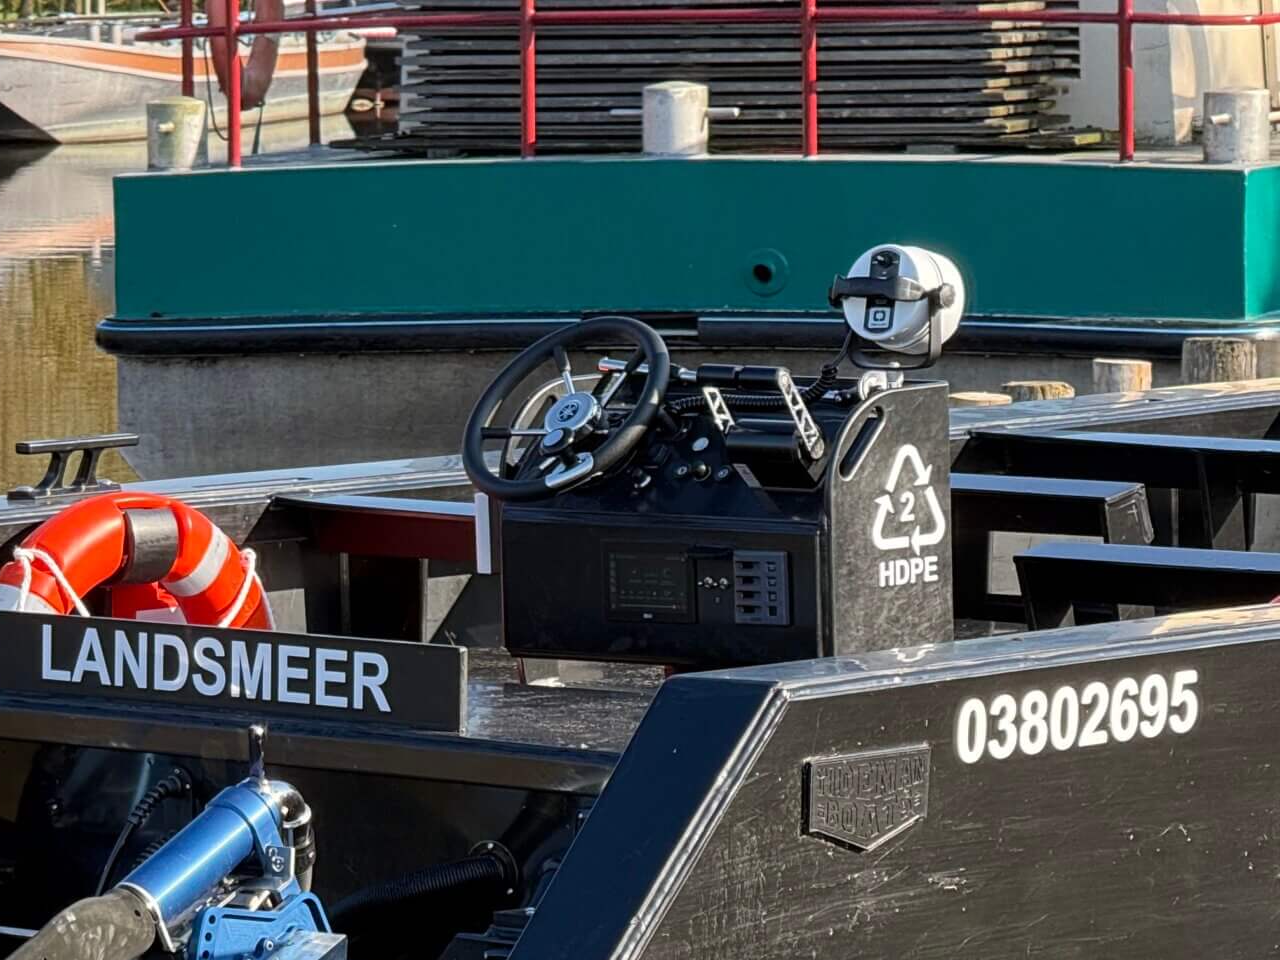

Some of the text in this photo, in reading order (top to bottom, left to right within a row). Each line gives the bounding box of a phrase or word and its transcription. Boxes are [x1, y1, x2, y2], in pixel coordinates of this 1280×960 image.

[899, 490, 916, 523] 2
[878, 555, 939, 588] HDPE
[41, 623, 393, 713] LANDSMEER
[956, 669, 1199, 764] 03802695
[817, 755, 927, 800] TIDEMAN
